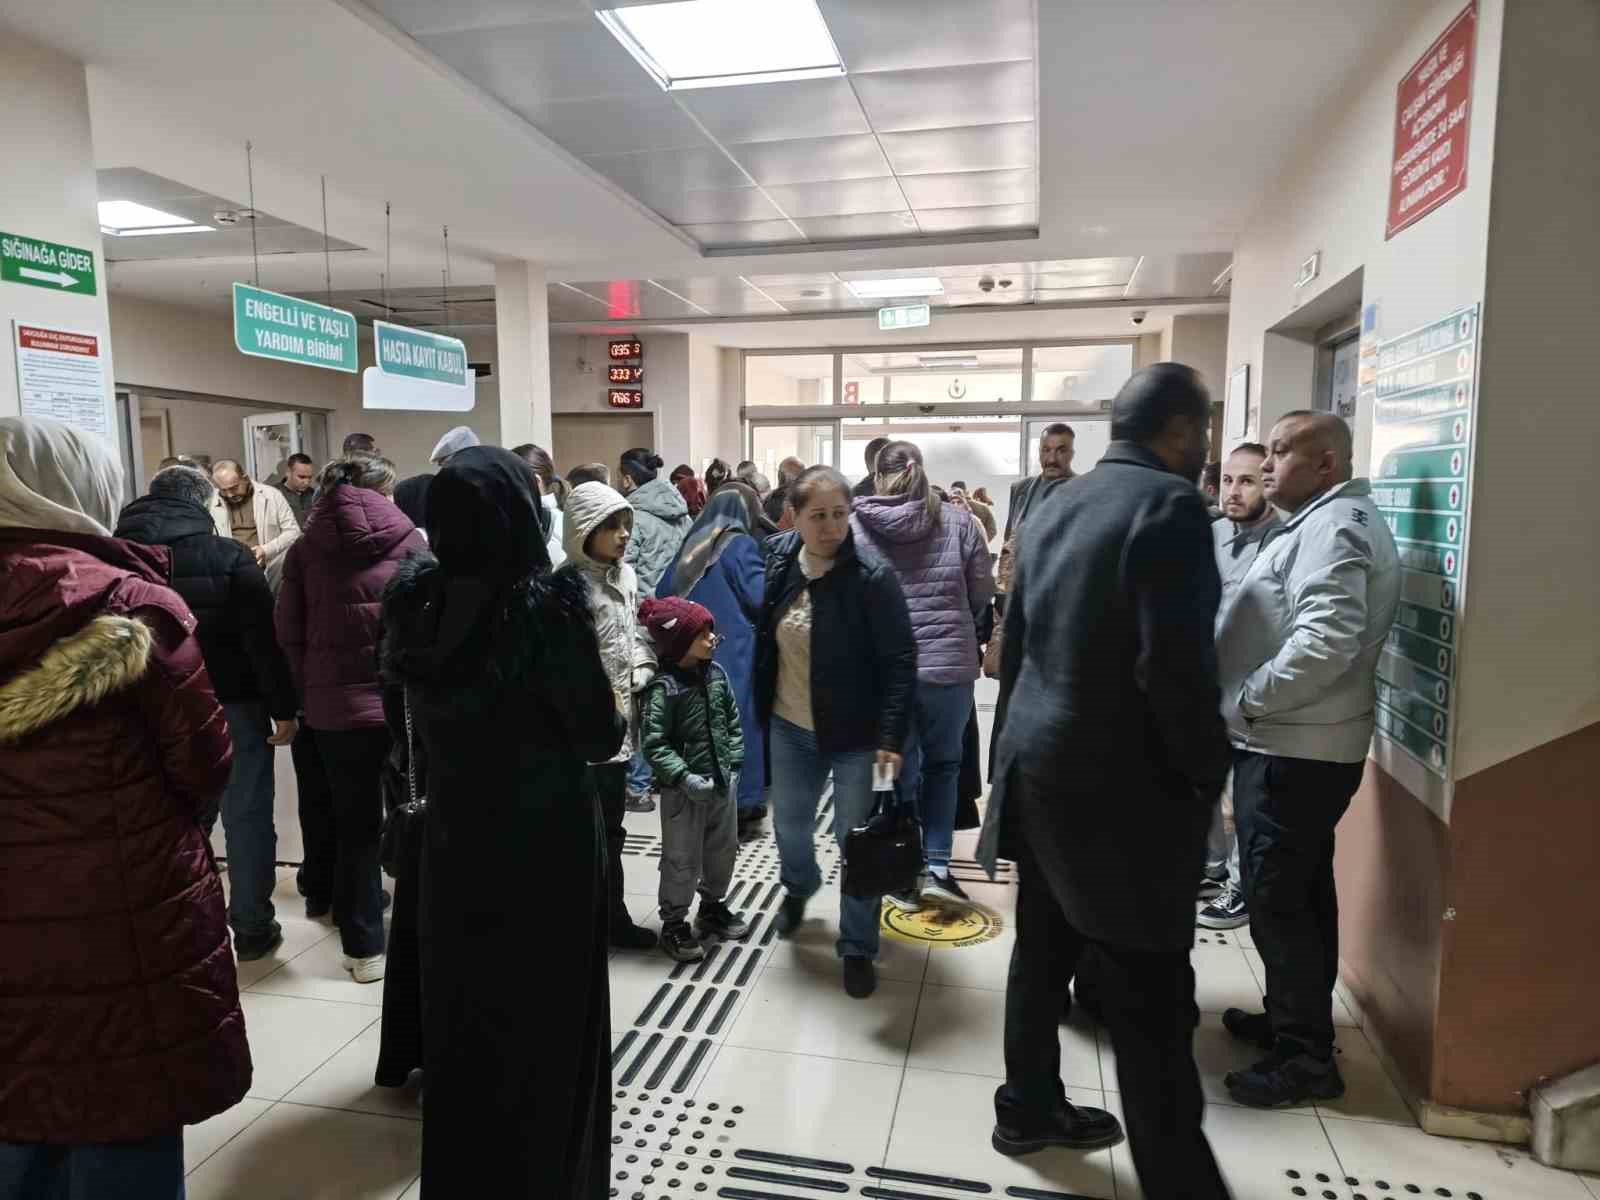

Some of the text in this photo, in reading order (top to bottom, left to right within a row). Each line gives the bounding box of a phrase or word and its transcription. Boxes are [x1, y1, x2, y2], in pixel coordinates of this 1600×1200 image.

[2, 237, 92, 272] SIĞINAĞA GİDER
[245, 298, 349, 339] ENGELLİ VE YAŞLI
[255, 328, 343, 362] YARDIM BİRİMİ
[383, 338, 411, 367] HASTA
[413, 344, 436, 369] KAYIT
